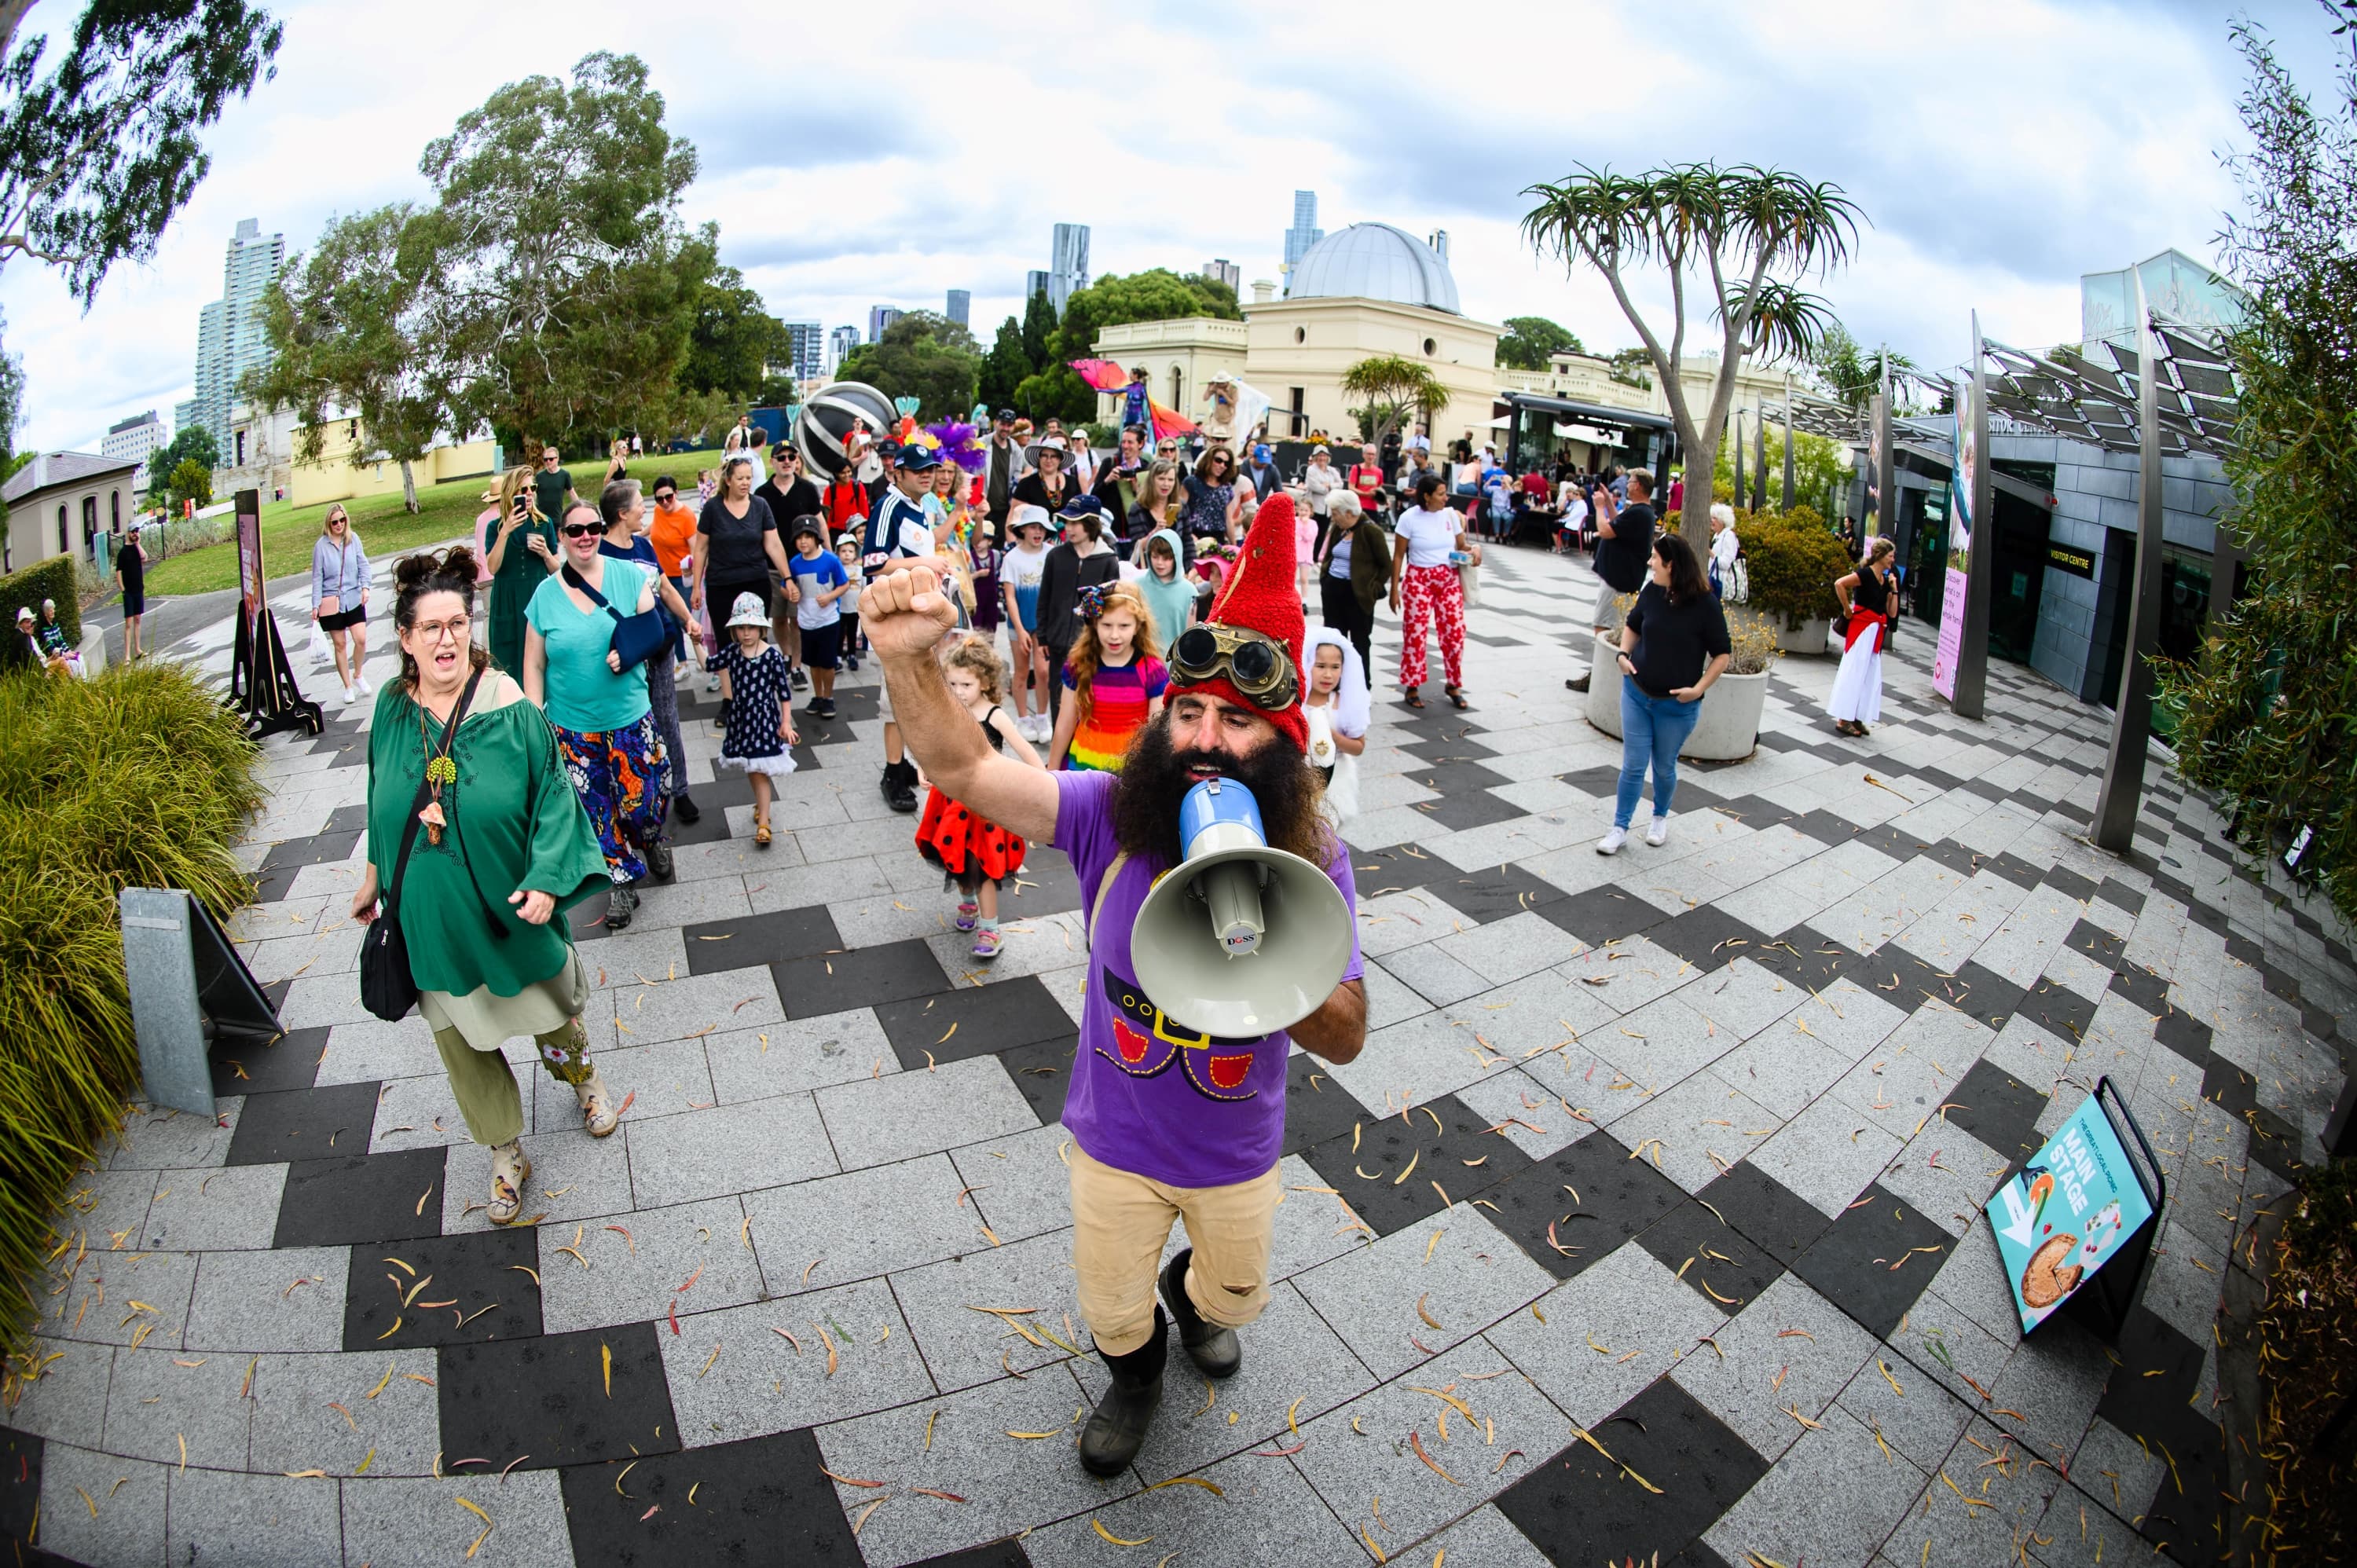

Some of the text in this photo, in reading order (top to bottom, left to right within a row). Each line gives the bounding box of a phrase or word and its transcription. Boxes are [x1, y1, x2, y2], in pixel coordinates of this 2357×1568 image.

[1988, 418, 2013, 433] SITOR
[2051, 548, 2089, 570] VISITOR CENTRE
[1227, 934, 1255, 945] DOSS
[2062, 1127, 2096, 1185] MAIN
[2079, 1117, 2117, 1193] THE GREAT LOCAL PICNIC
[2050, 1144, 2088, 1217] STAGE
